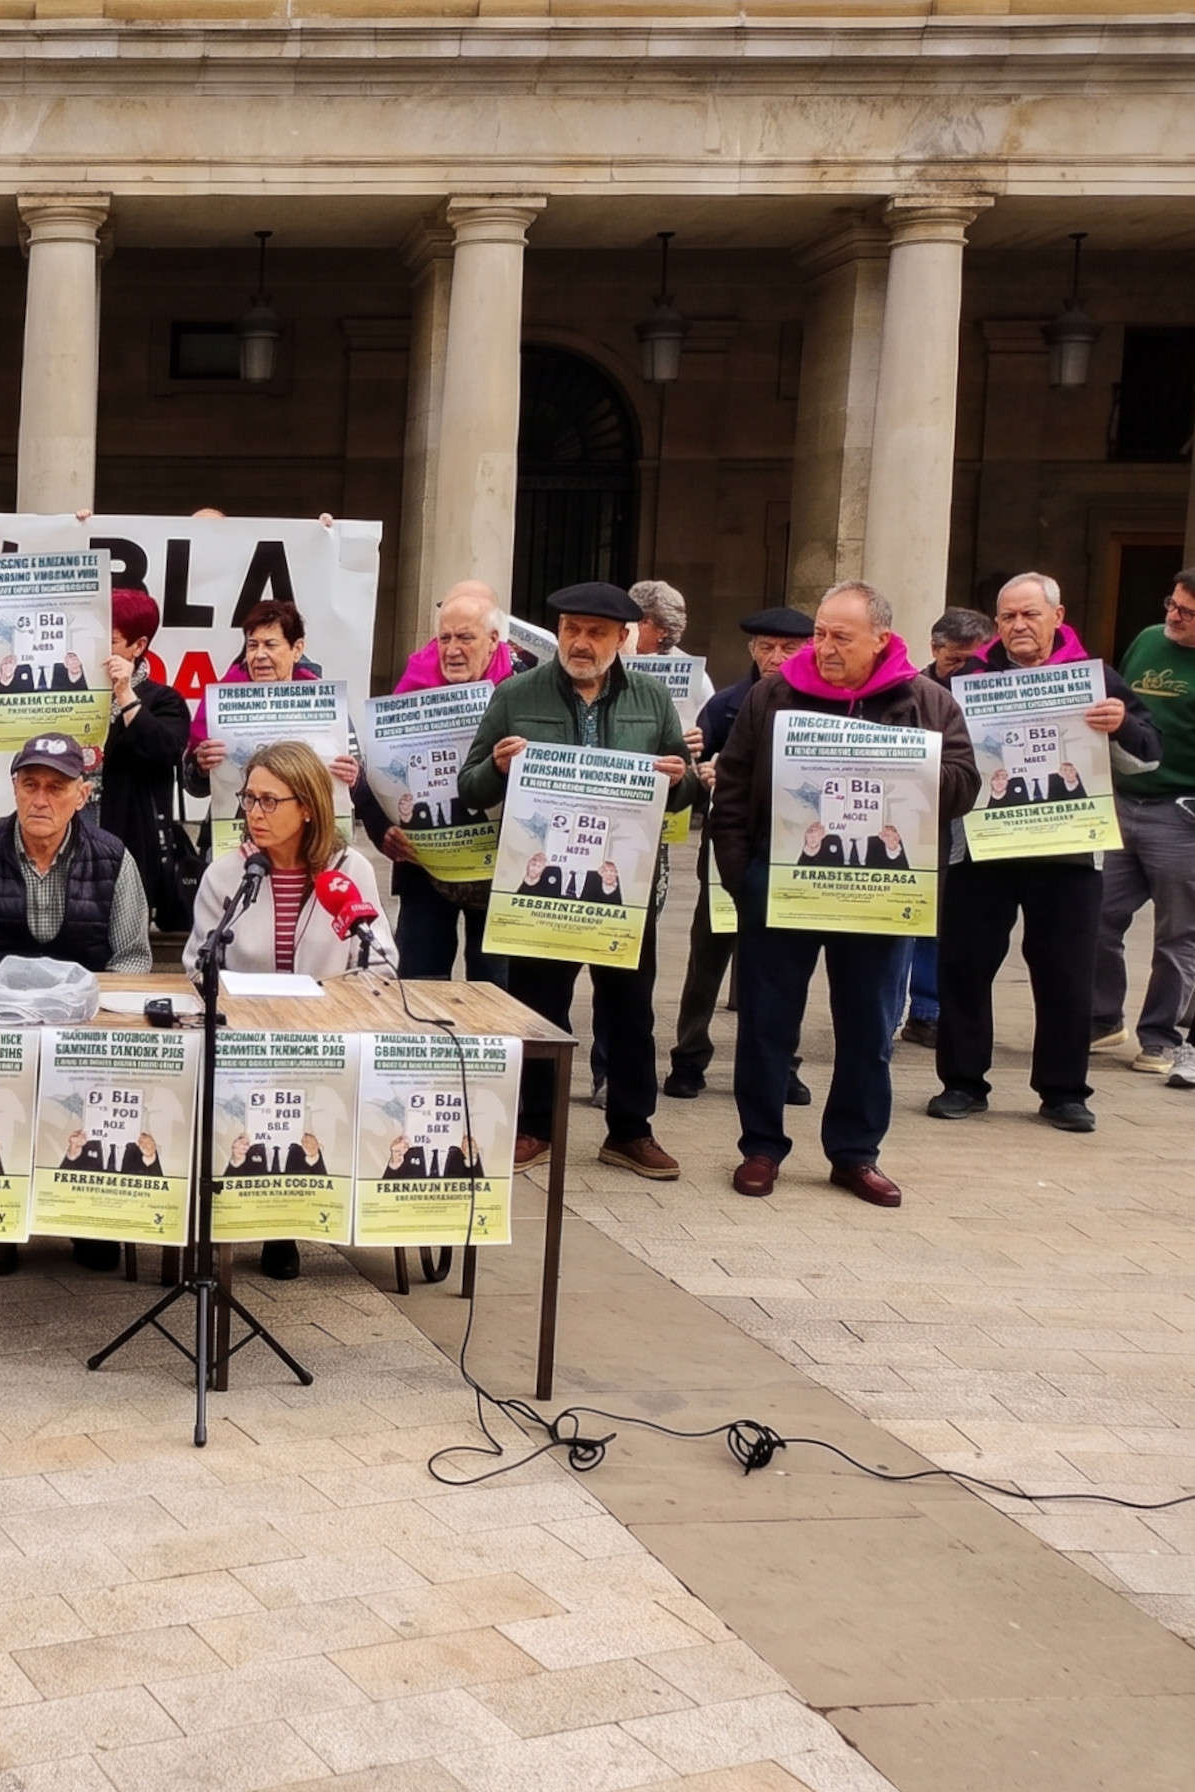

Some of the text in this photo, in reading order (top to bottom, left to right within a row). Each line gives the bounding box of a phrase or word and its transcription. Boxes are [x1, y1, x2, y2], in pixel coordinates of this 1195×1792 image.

[850, 780, 881, 794] Bla
[577, 816, 606, 830] Bla
[112, 1091, 139, 1104] Bla
[275, 1092, 301, 1104] Bla
[435, 1095, 462, 1106] Bla
